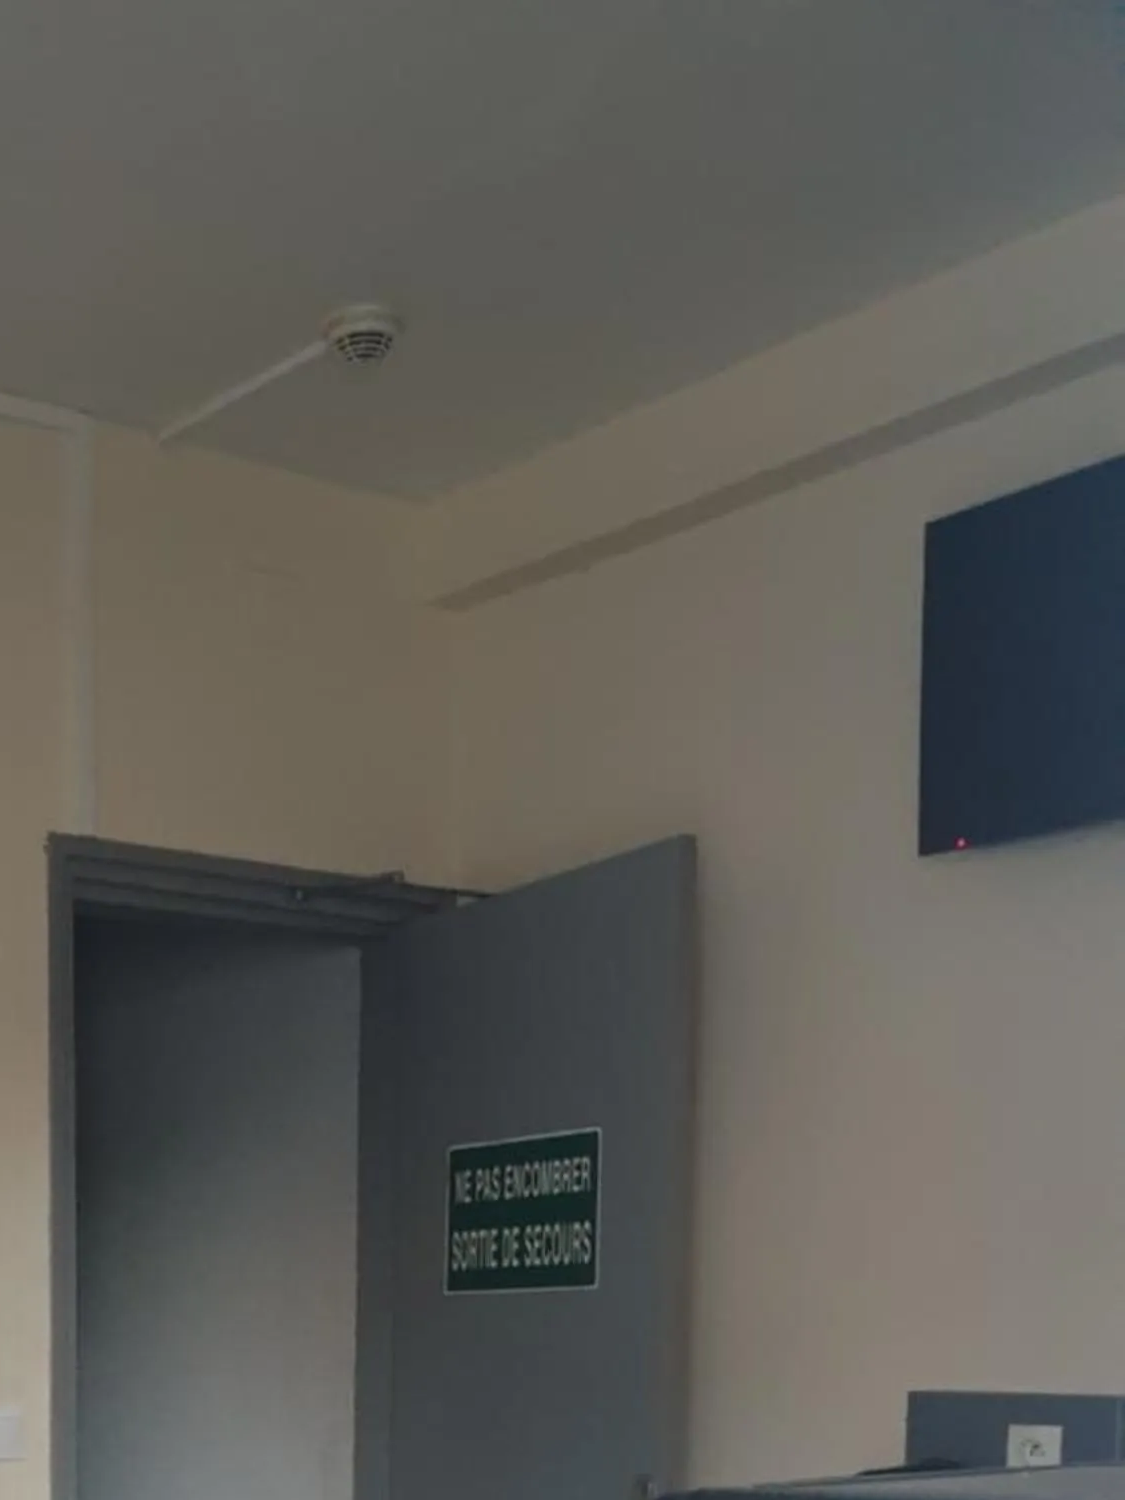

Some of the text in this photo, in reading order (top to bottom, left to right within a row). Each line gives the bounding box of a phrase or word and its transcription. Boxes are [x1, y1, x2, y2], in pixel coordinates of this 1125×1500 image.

[454, 1156, 591, 1203] NE PAS ENCOMBRER
[452, 1220, 591, 1271] SORTIE DE SECOURS
